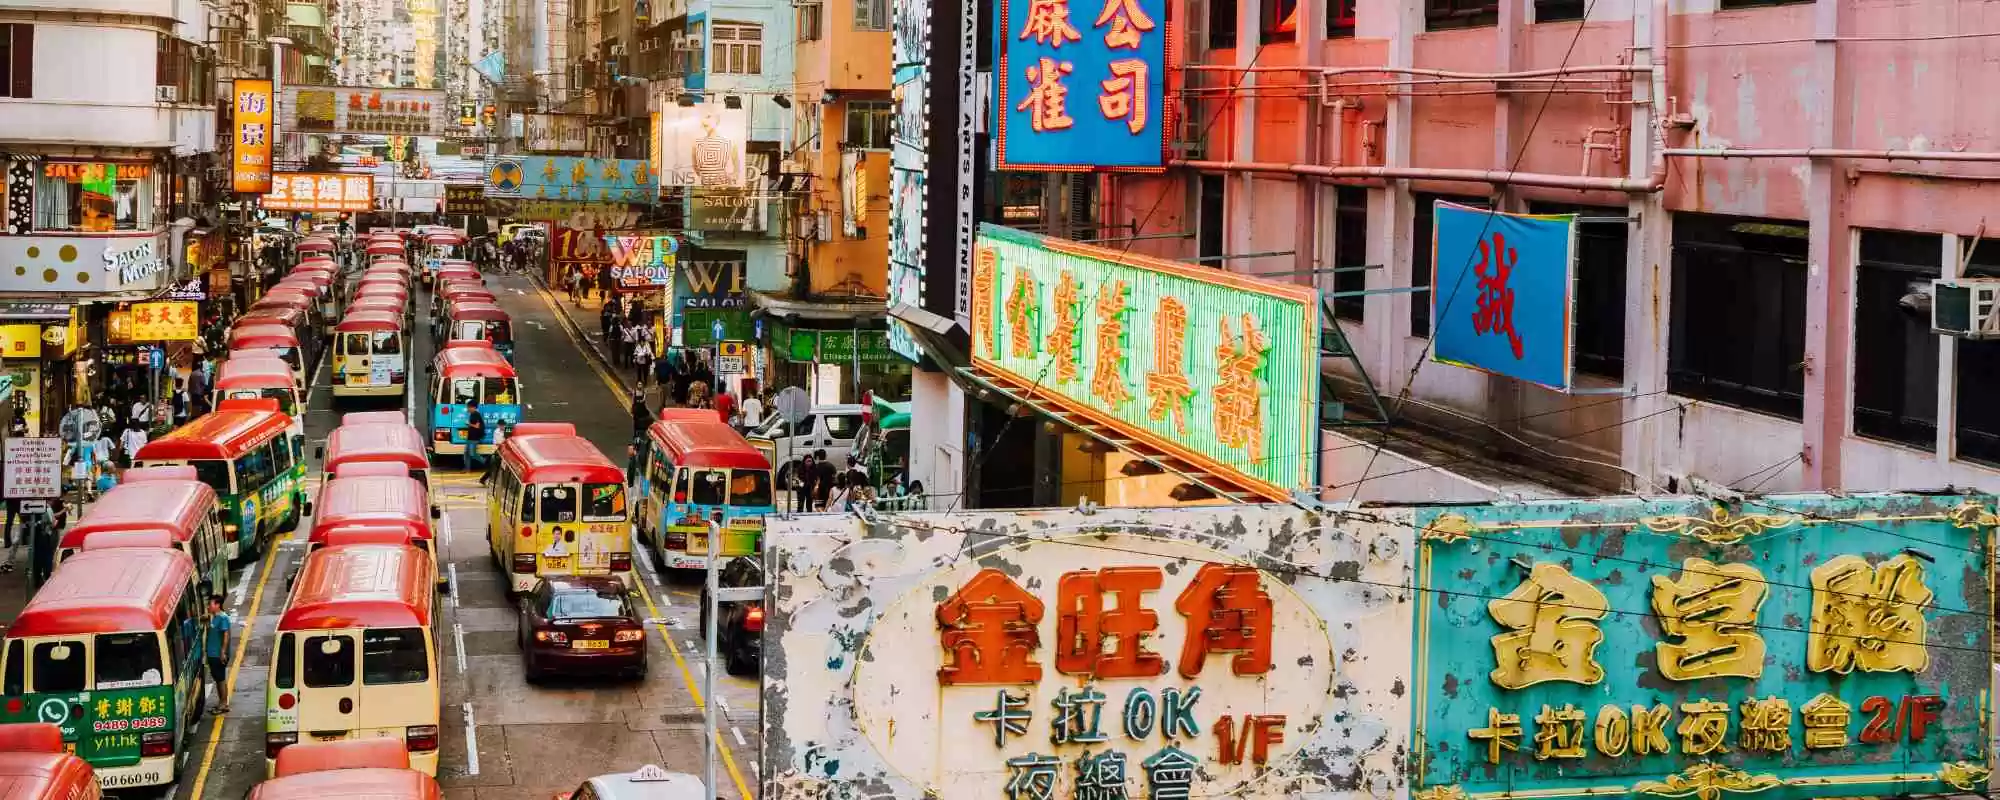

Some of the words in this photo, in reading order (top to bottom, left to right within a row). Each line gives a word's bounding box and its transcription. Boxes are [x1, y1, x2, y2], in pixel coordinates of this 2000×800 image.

[962, 0, 974, 103] MARTIAL
[1093, 0, 1156, 135] 公司
[962, 112, 972, 174] ARTS
[703, 195, 756, 208] SALON
[962, 184, 970, 200] &
[103, 240, 152, 272] SALON
[119, 258, 165, 286] MORE
[602, 235, 680, 267] WP
[610, 265, 670, 279] SALON
[959, 211, 969, 314] FITNESS
[935, 562, 1273, 687] 金旺角
[94, 719, 129, 732] 9489
[973, 686, 1202, 748] 卡拉OK
[1212, 714, 1288, 766] 1/F
[1858, 694, 1946, 744] 2/F
[144, 771, 160, 783] 90
[1003, 745, 1198, 800] 夜總會
